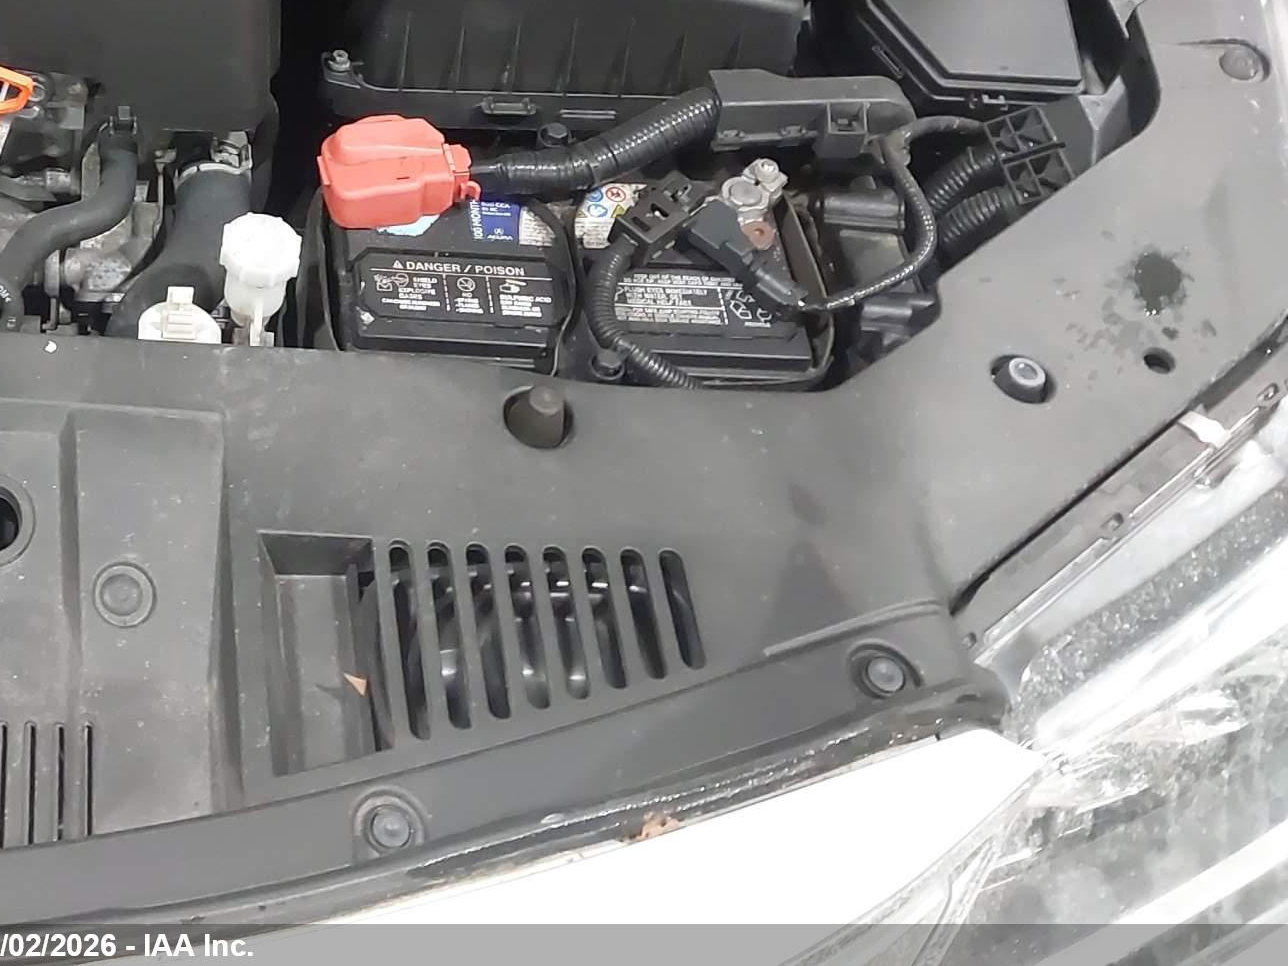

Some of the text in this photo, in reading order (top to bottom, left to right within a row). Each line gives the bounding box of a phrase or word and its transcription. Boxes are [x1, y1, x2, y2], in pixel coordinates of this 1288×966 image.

[405, 261, 525, 277] DANGER / POISON
